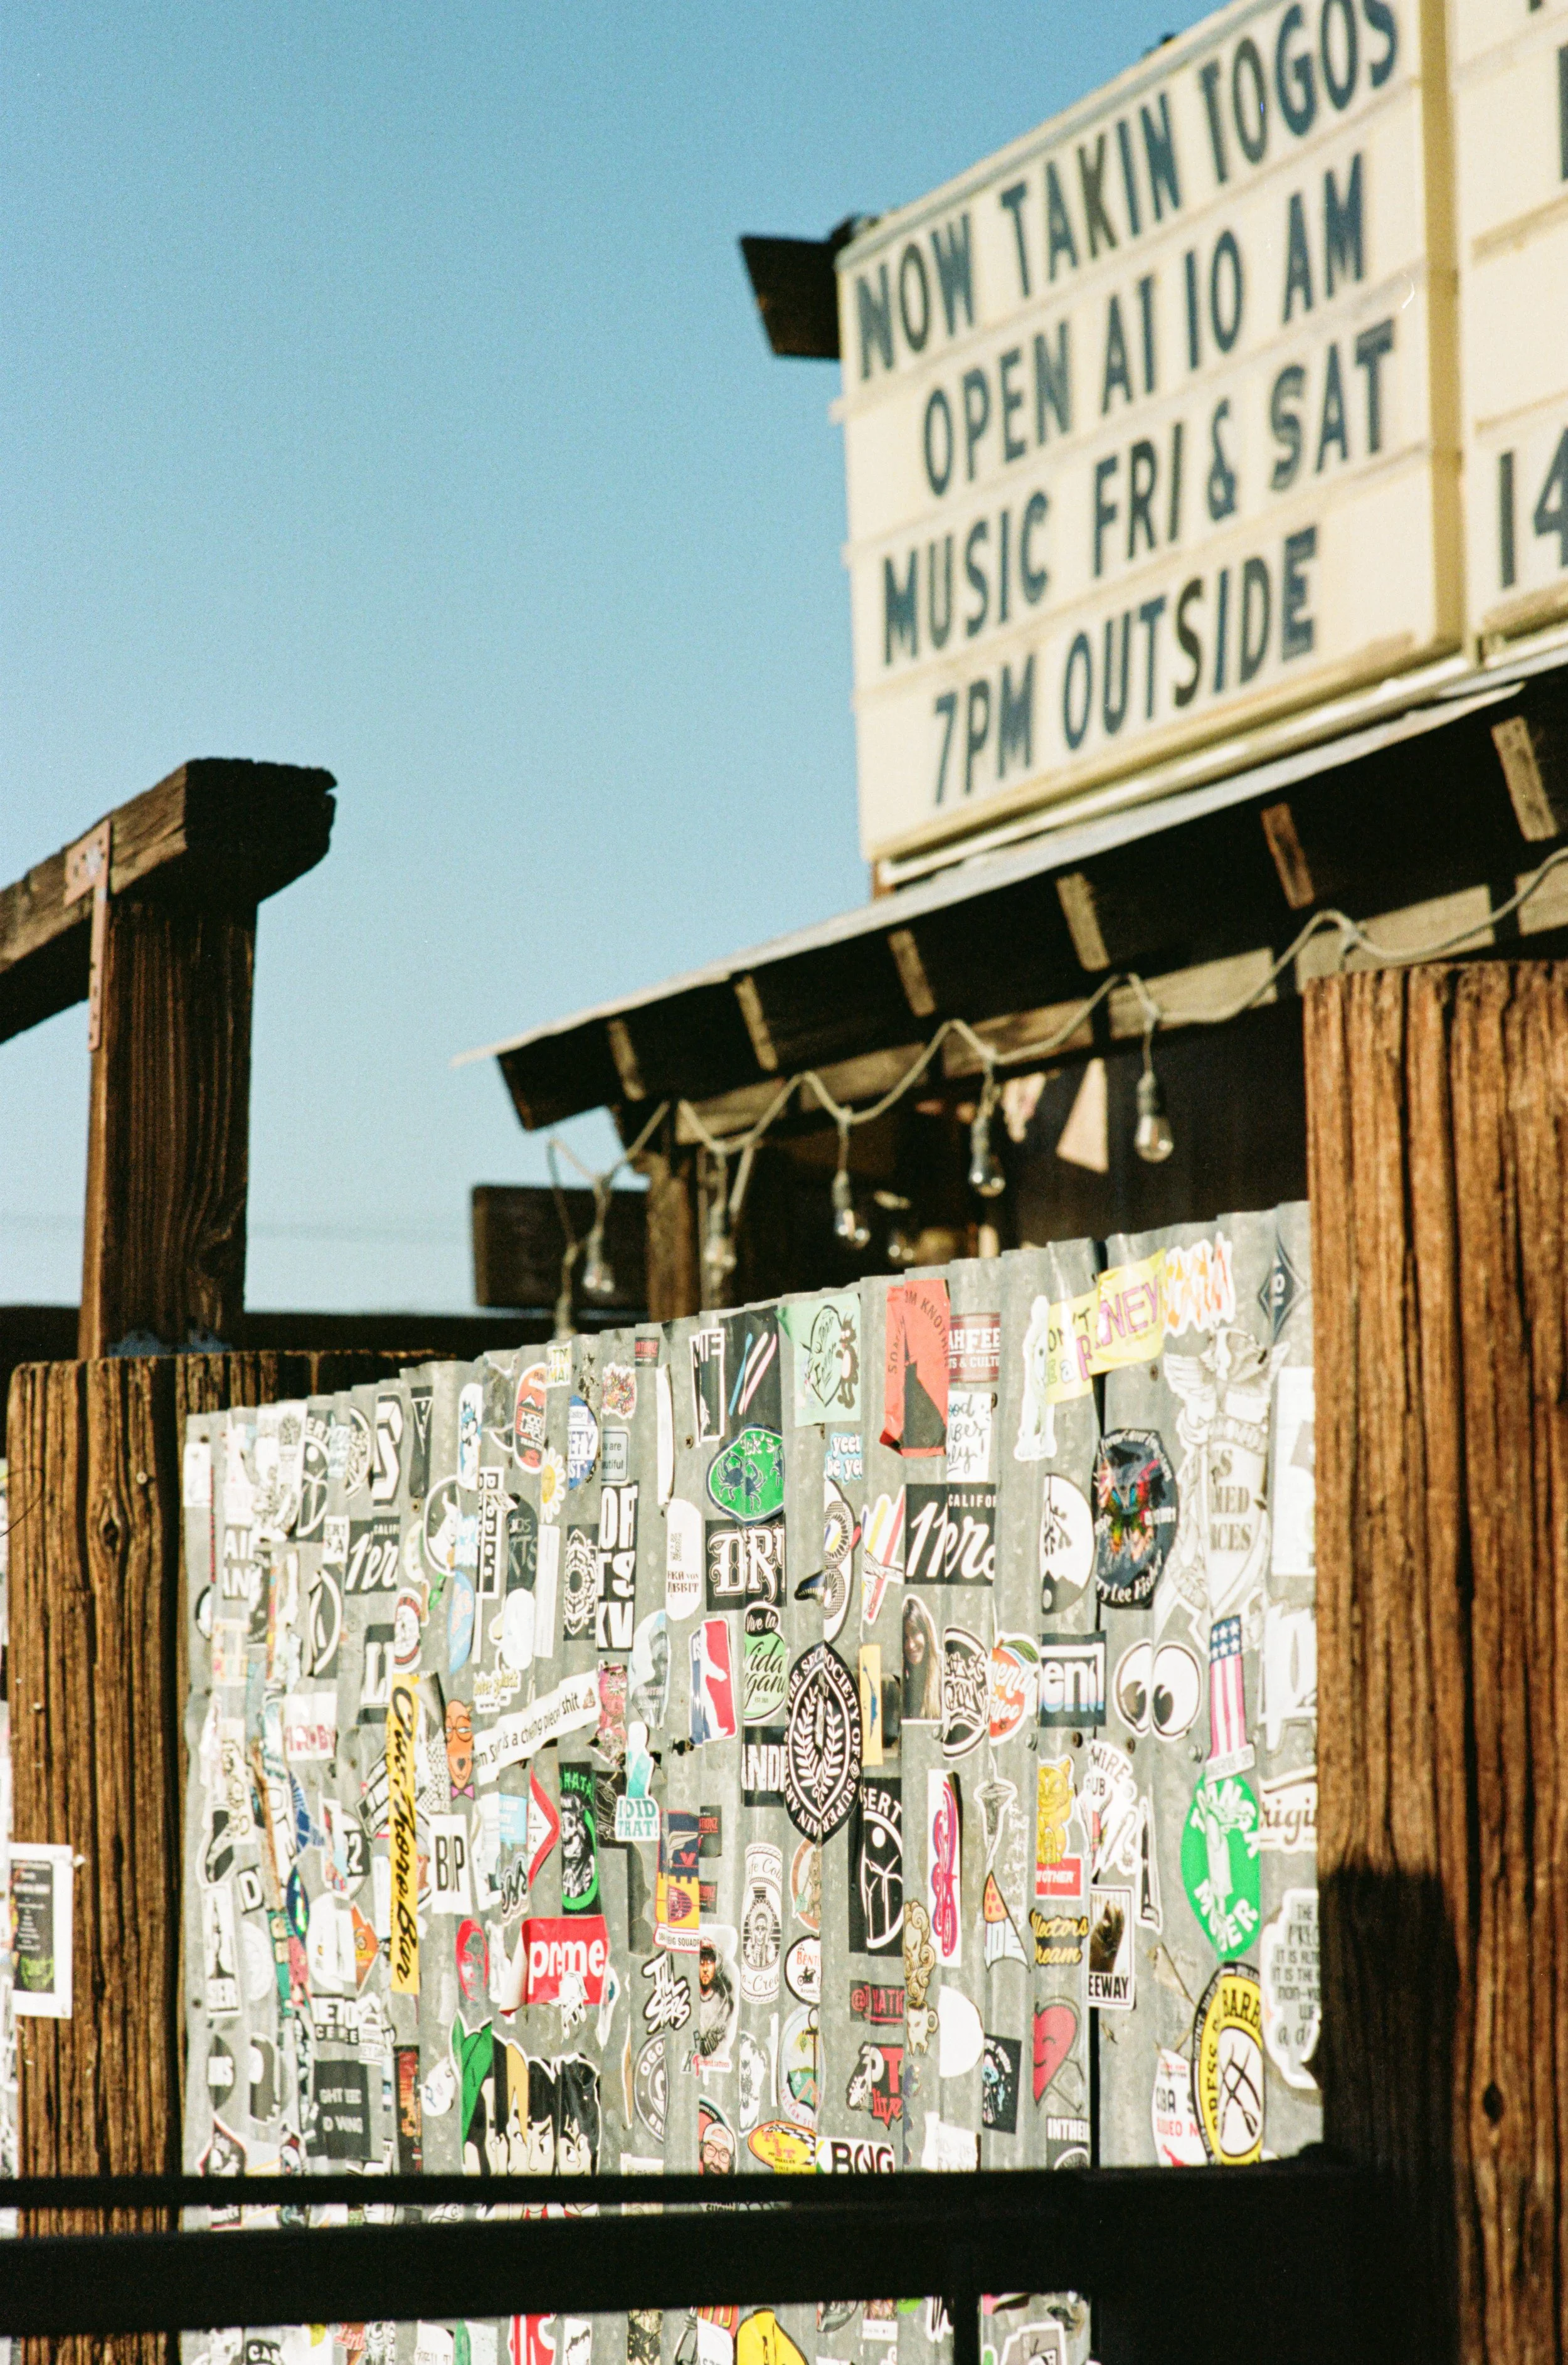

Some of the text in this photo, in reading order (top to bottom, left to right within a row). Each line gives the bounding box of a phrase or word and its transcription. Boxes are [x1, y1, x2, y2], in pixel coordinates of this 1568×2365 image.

[854, 211, 976, 380] NOW
[1000, 90, 1180, 299] TAKIN
[922, 318, 1073, 497] OPEN
[1100, 274, 1158, 417] AT
[1281, 152, 1366, 326] AM
[884, 317, 1396, 666] MUSIC FRI & SAT
[933, 524, 1318, 806] 7PM OUTSIDE
[948, 1394, 974, 1418] ood
[569, 1431, 595, 1455] ETY
[824, 1648, 860, 1721] OCIETY
[561, 1692, 580, 1715] shit
[625, 1799, 657, 1818] DID
[617, 1819, 658, 1837] THAT!
[1088, 1975, 1129, 2000] EEWAY
